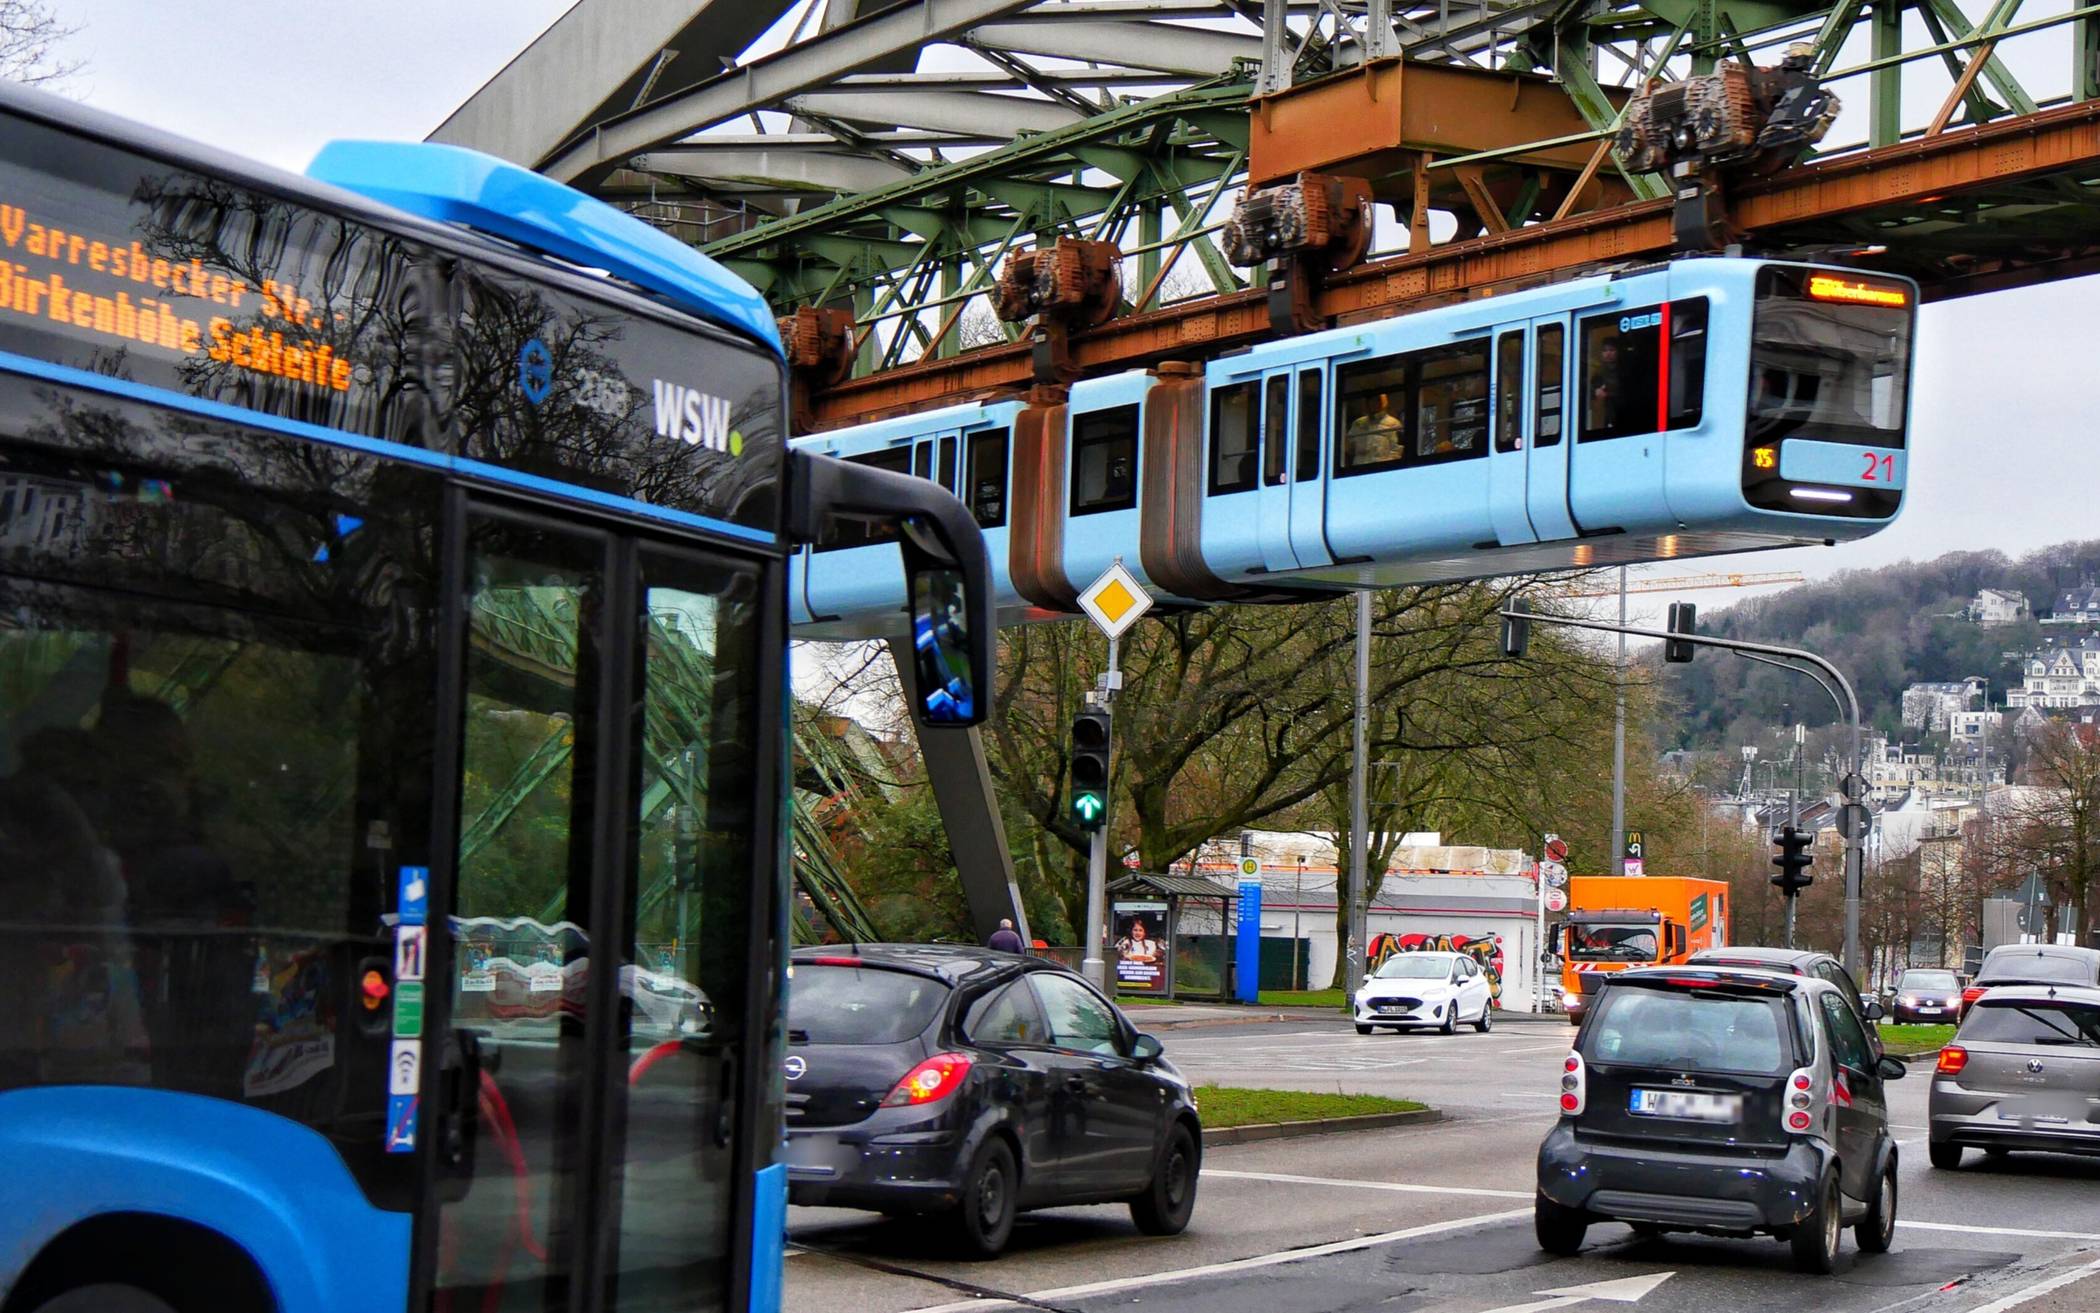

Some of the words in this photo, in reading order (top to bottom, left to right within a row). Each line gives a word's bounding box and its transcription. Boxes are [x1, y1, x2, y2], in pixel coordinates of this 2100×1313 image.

[0, 203, 248, 308] Varresbecker
[207, 316, 351, 393] Schleife
[1861, 452, 1894, 482] 21
